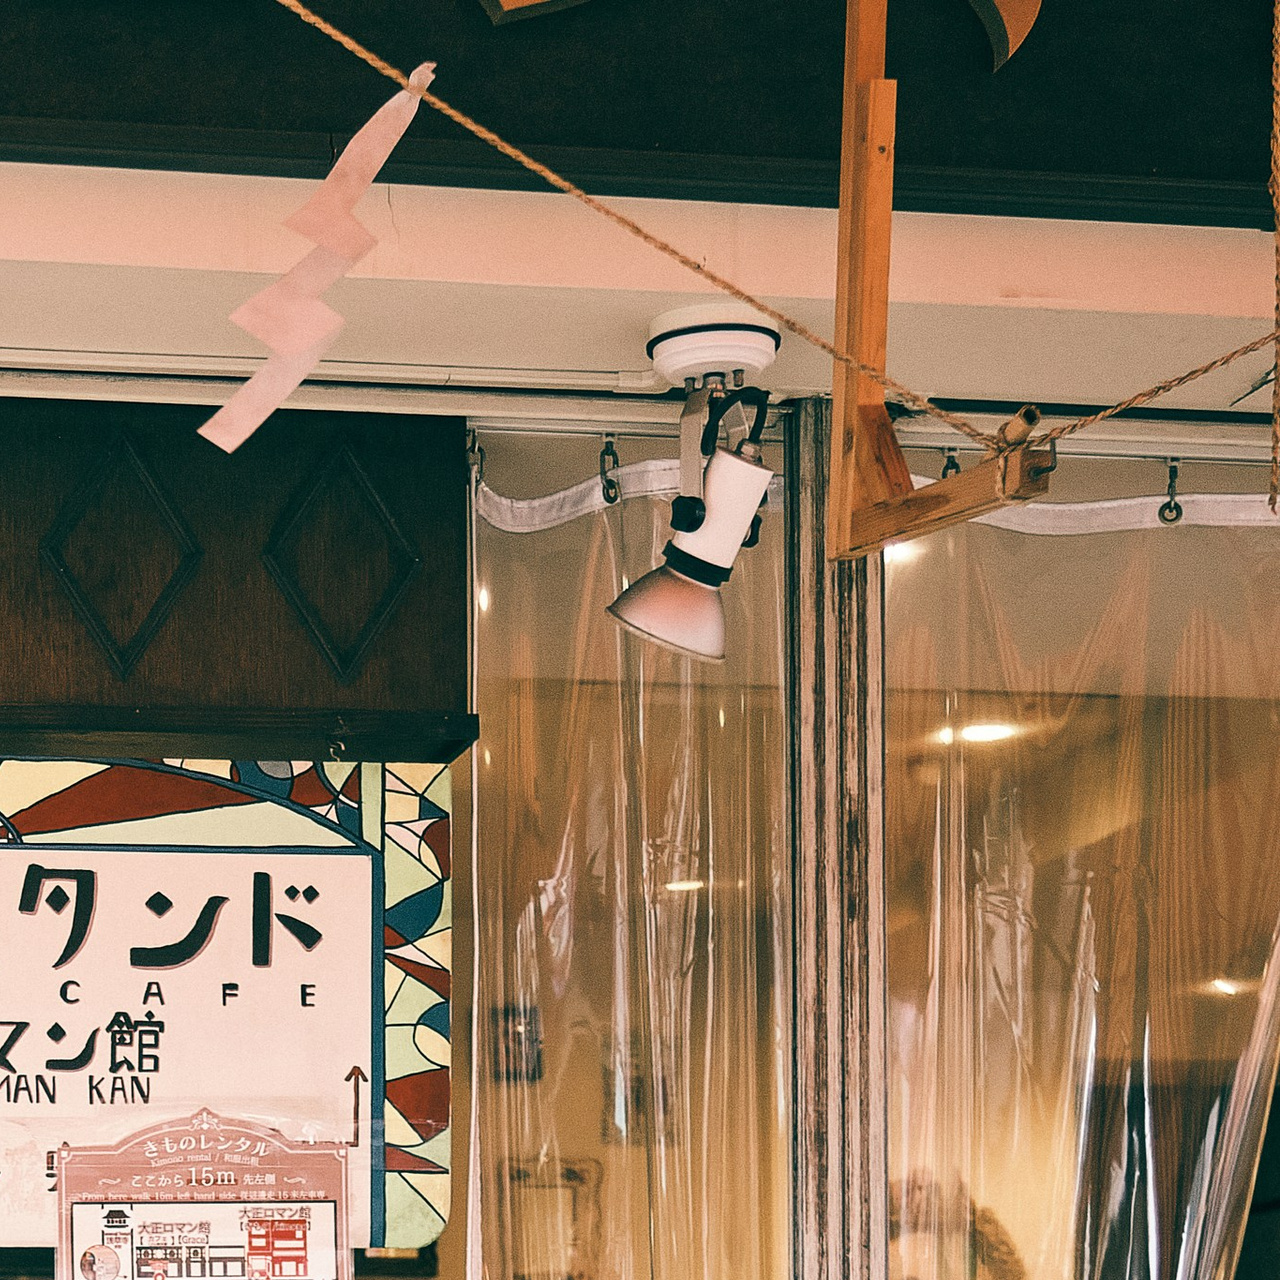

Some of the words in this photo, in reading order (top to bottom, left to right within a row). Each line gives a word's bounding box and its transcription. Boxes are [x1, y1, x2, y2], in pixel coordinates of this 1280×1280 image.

[58, 978, 318, 1009] CAFE
[88, 1074, 152, 1106] KAN
[143, 1135, 270, 1158] きものレンタル
[151, 1154, 184, 1166] Kimono
[187, 1152, 212, 1163] rental
[187, 1167, 236, 1186] 15m
[239, 1206, 311, 1219] 大正ロマン館
[138, 1222, 211, 1235] 大正ロマン館
